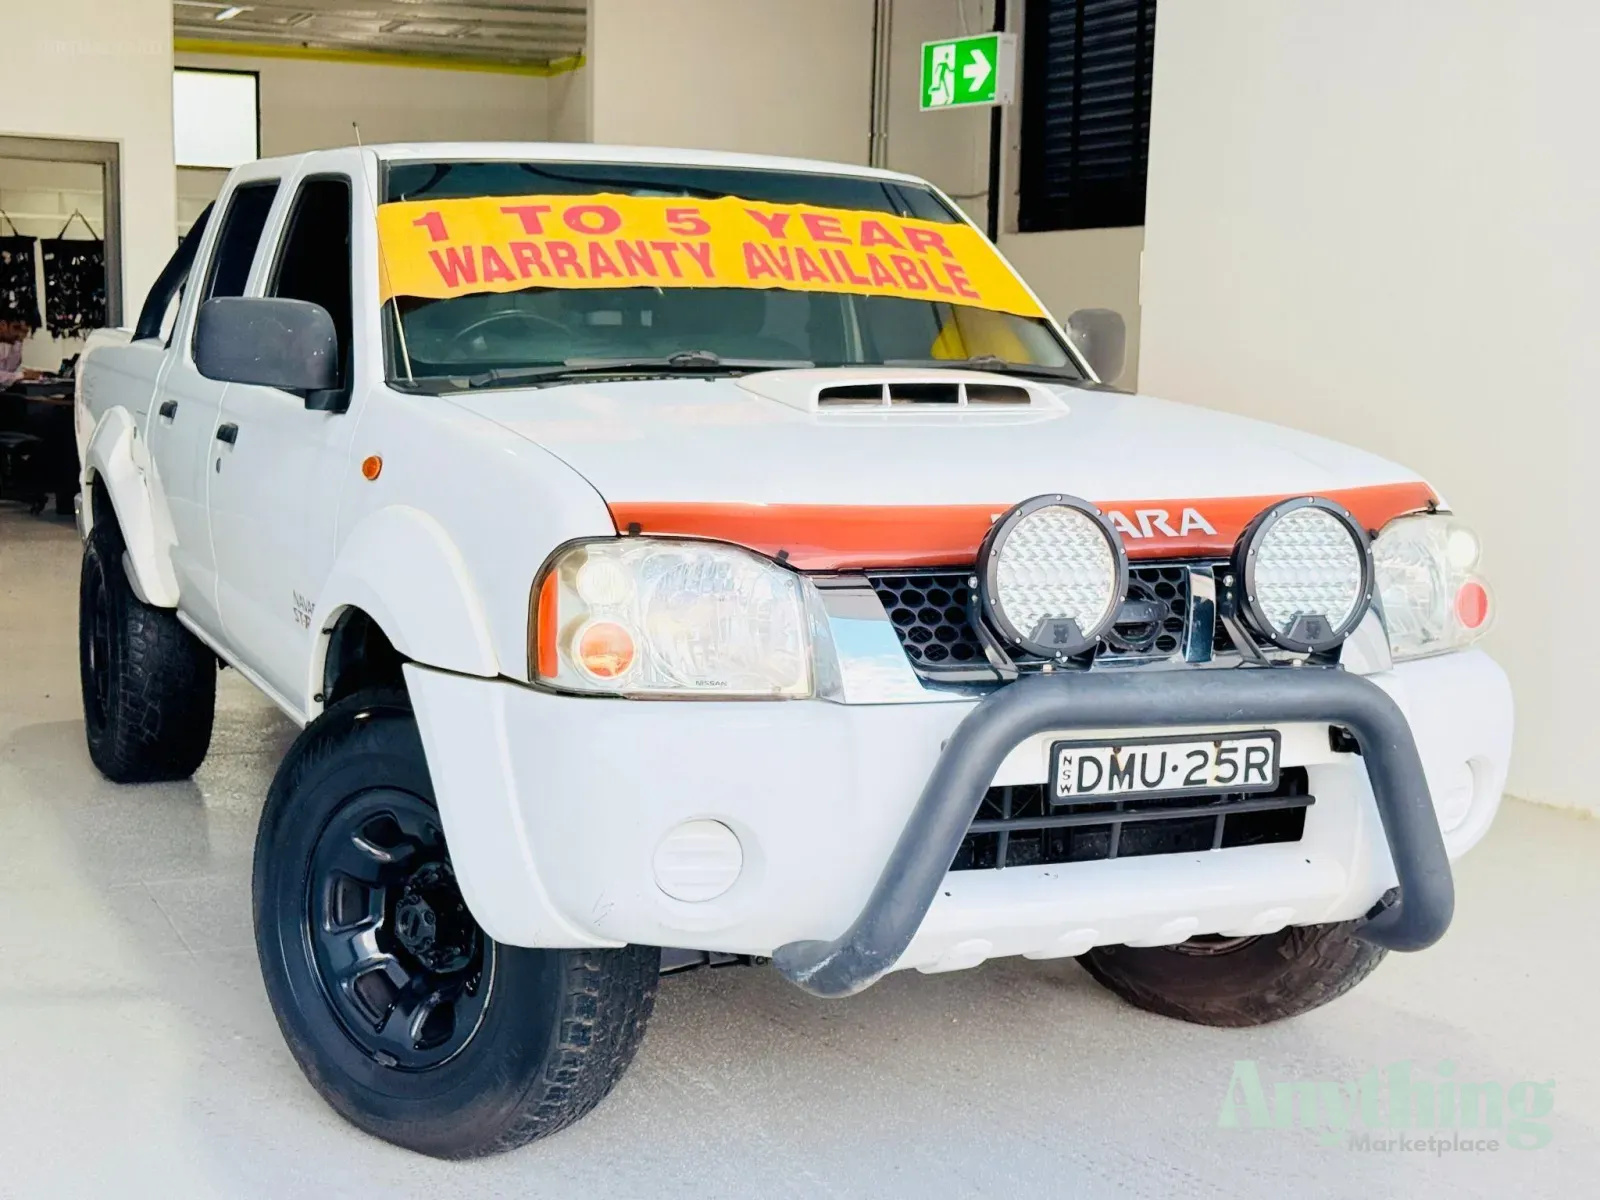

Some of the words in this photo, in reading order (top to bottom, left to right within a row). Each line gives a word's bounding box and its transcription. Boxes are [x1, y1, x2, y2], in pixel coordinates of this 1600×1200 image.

[412, 211, 447, 241] 1
[501, 206, 621, 235] TO
[667, 209, 711, 235] 5
[745, 209, 955, 257] YEAR
[428, 240, 713, 287] WARRANTY
[744, 242, 980, 298] AVAILABLE
